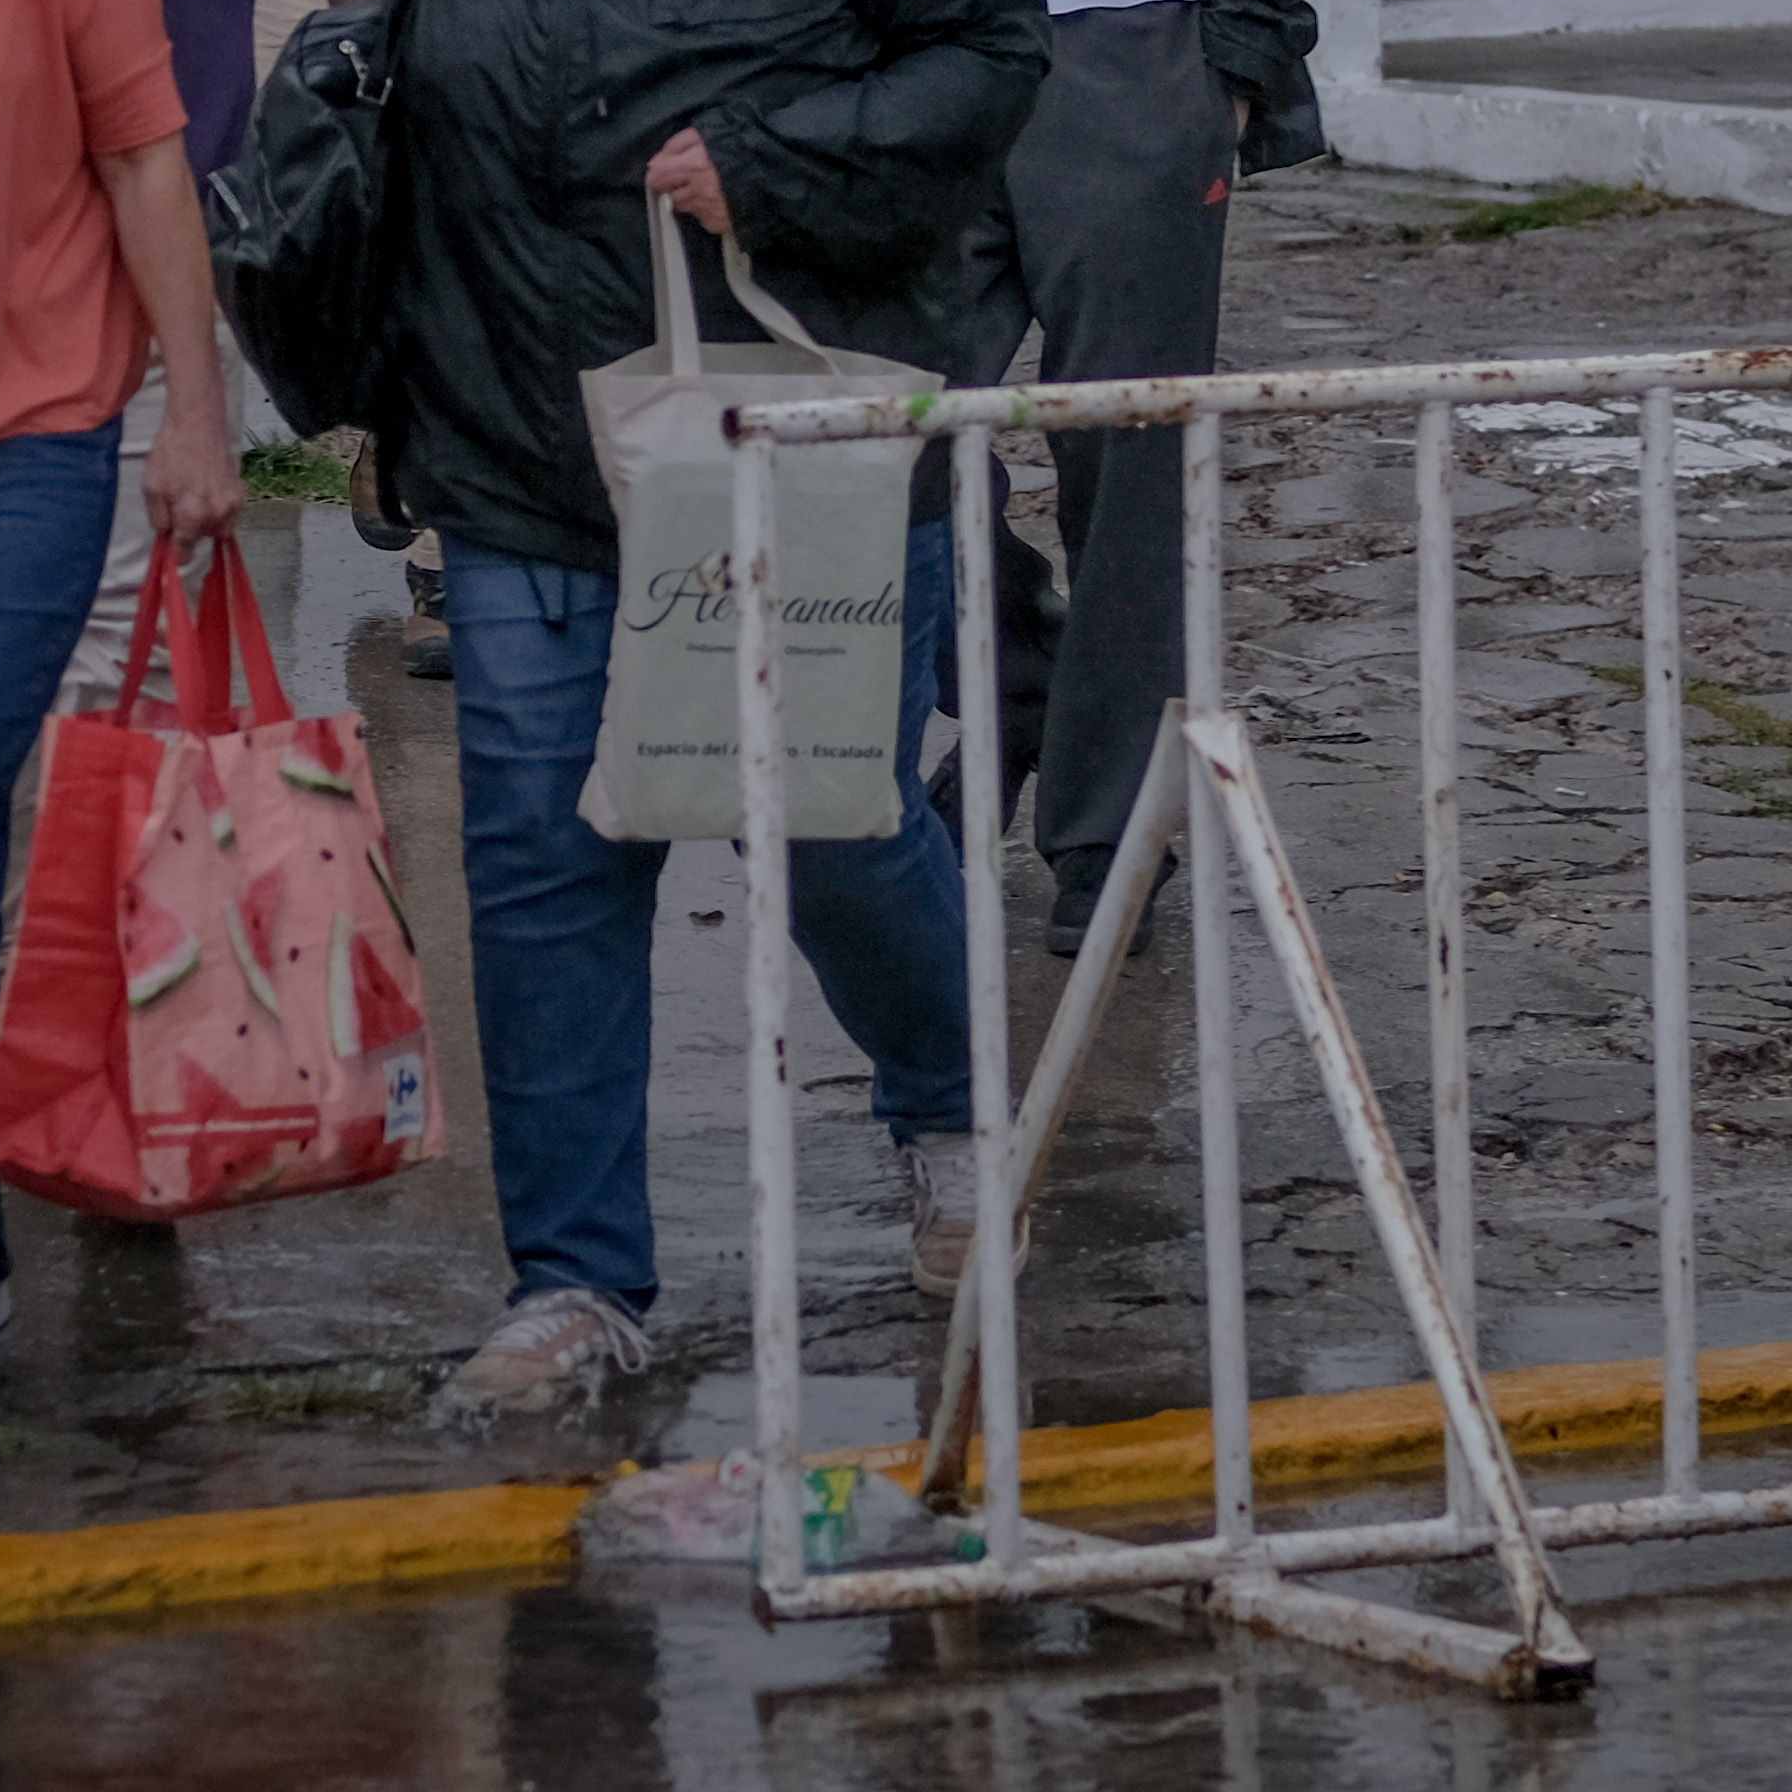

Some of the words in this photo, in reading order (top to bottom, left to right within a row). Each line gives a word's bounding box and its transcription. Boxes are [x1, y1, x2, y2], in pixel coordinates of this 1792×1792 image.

[637, 742, 698, 758] Espacio
[702, 741, 727, 756] del
[812, 744, 884, 759] Escalada
